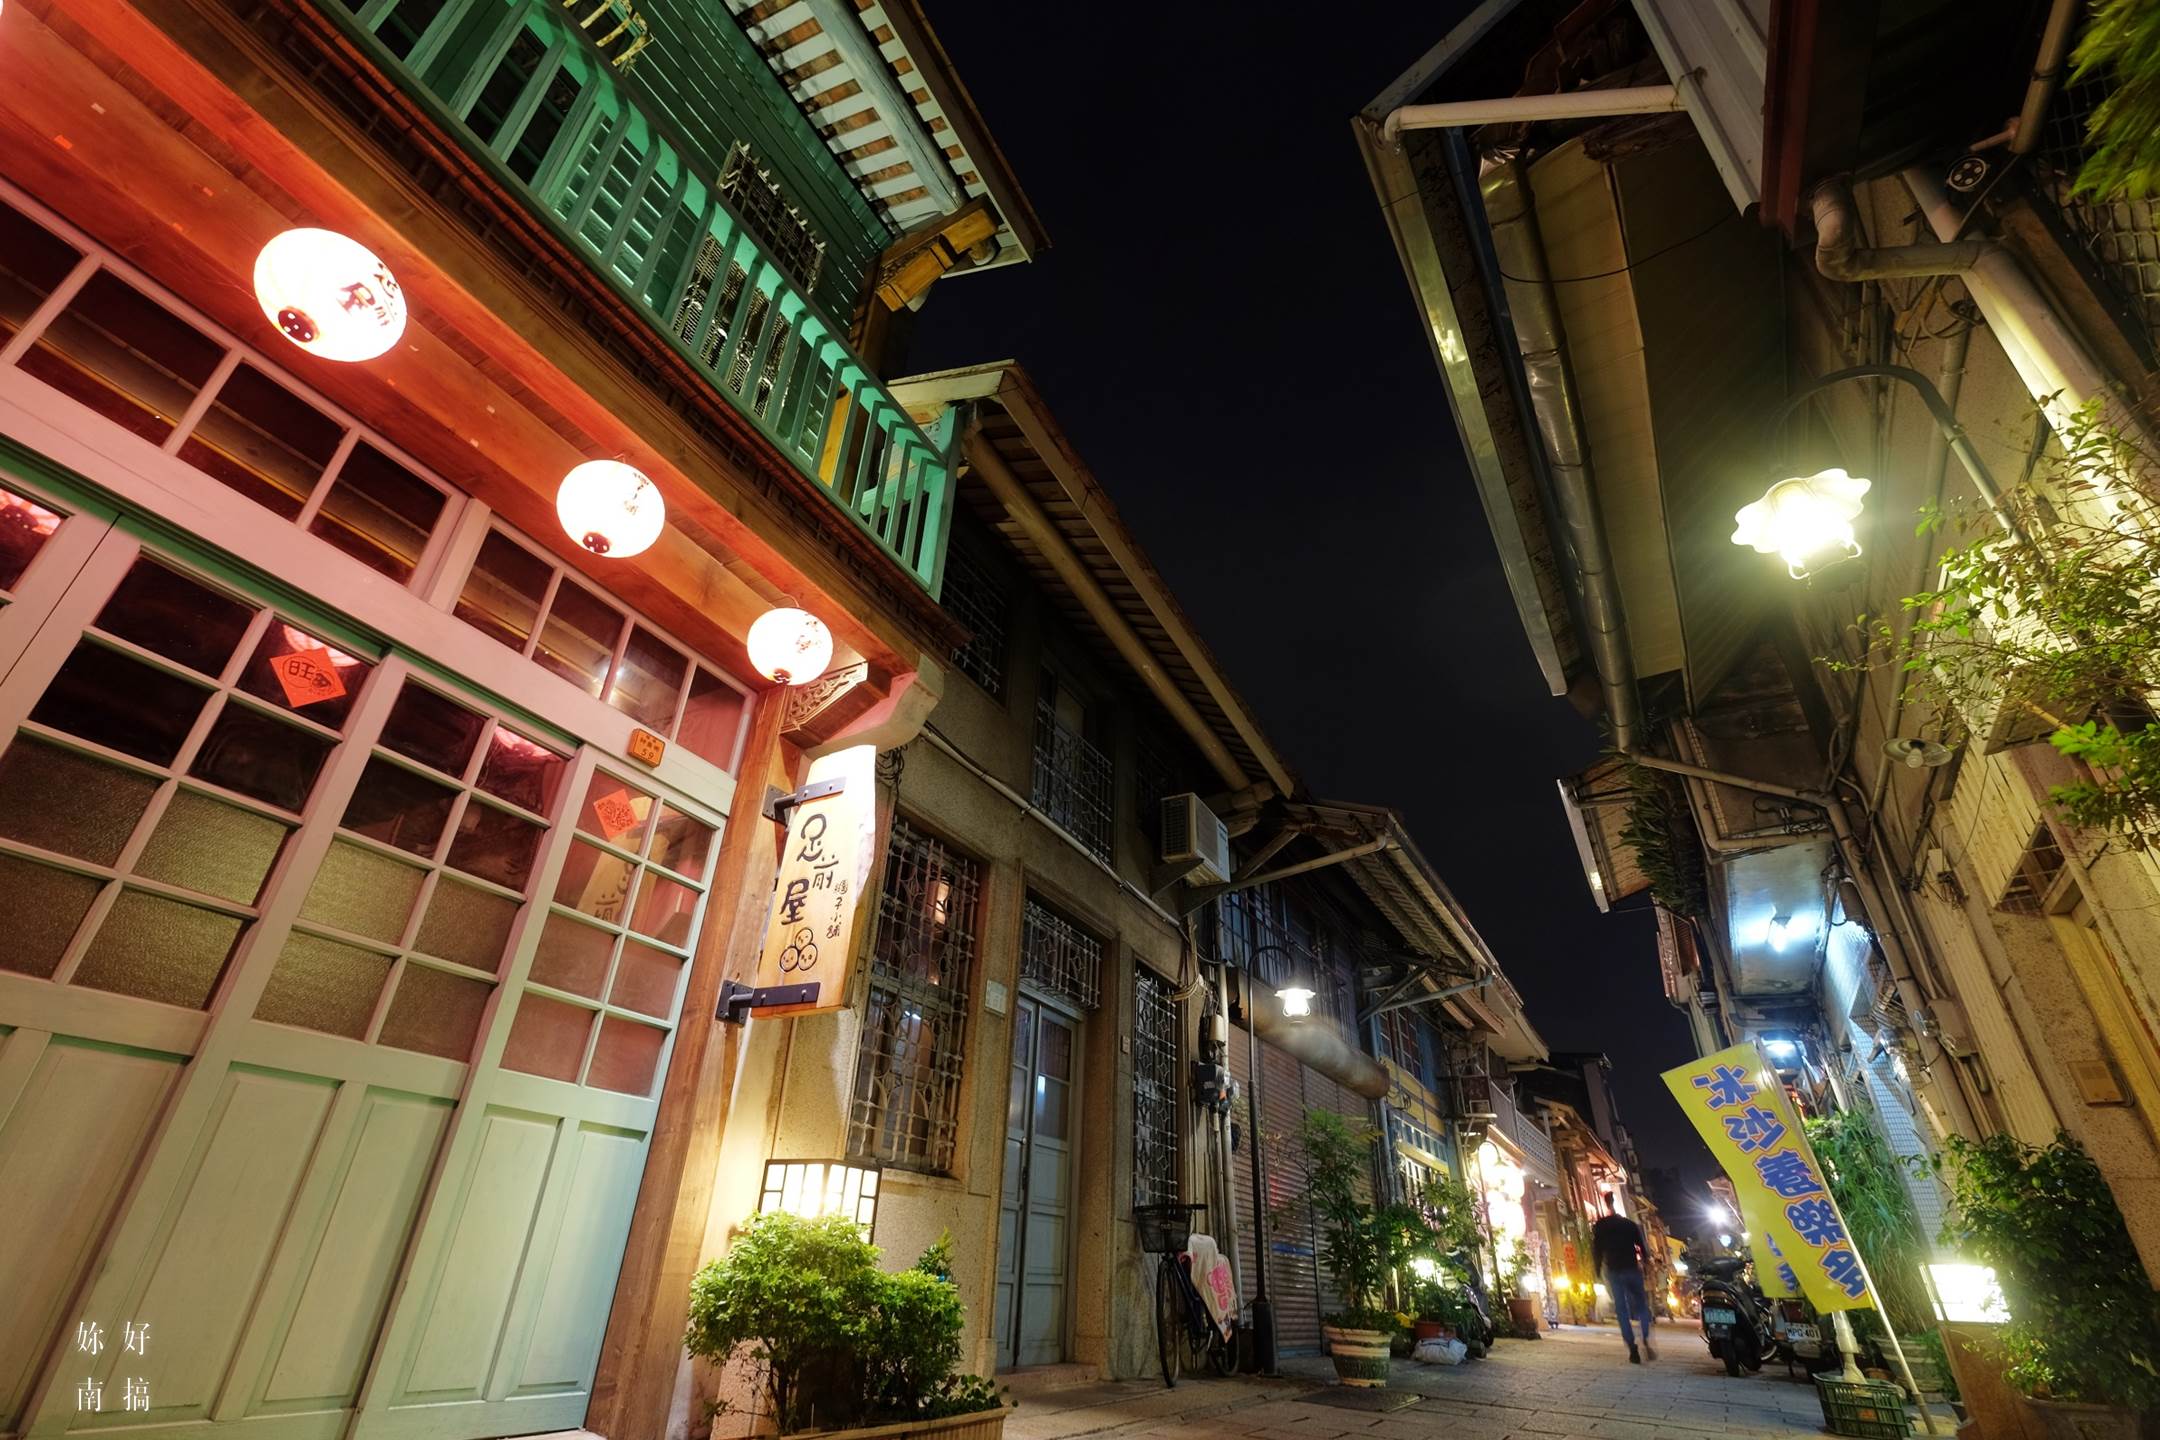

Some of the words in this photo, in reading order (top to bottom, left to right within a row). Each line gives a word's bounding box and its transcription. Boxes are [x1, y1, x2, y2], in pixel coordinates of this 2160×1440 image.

[640, 748, 654, 759] 59
[1692, 1065, 1866, 1299] 冰沙養樂多
